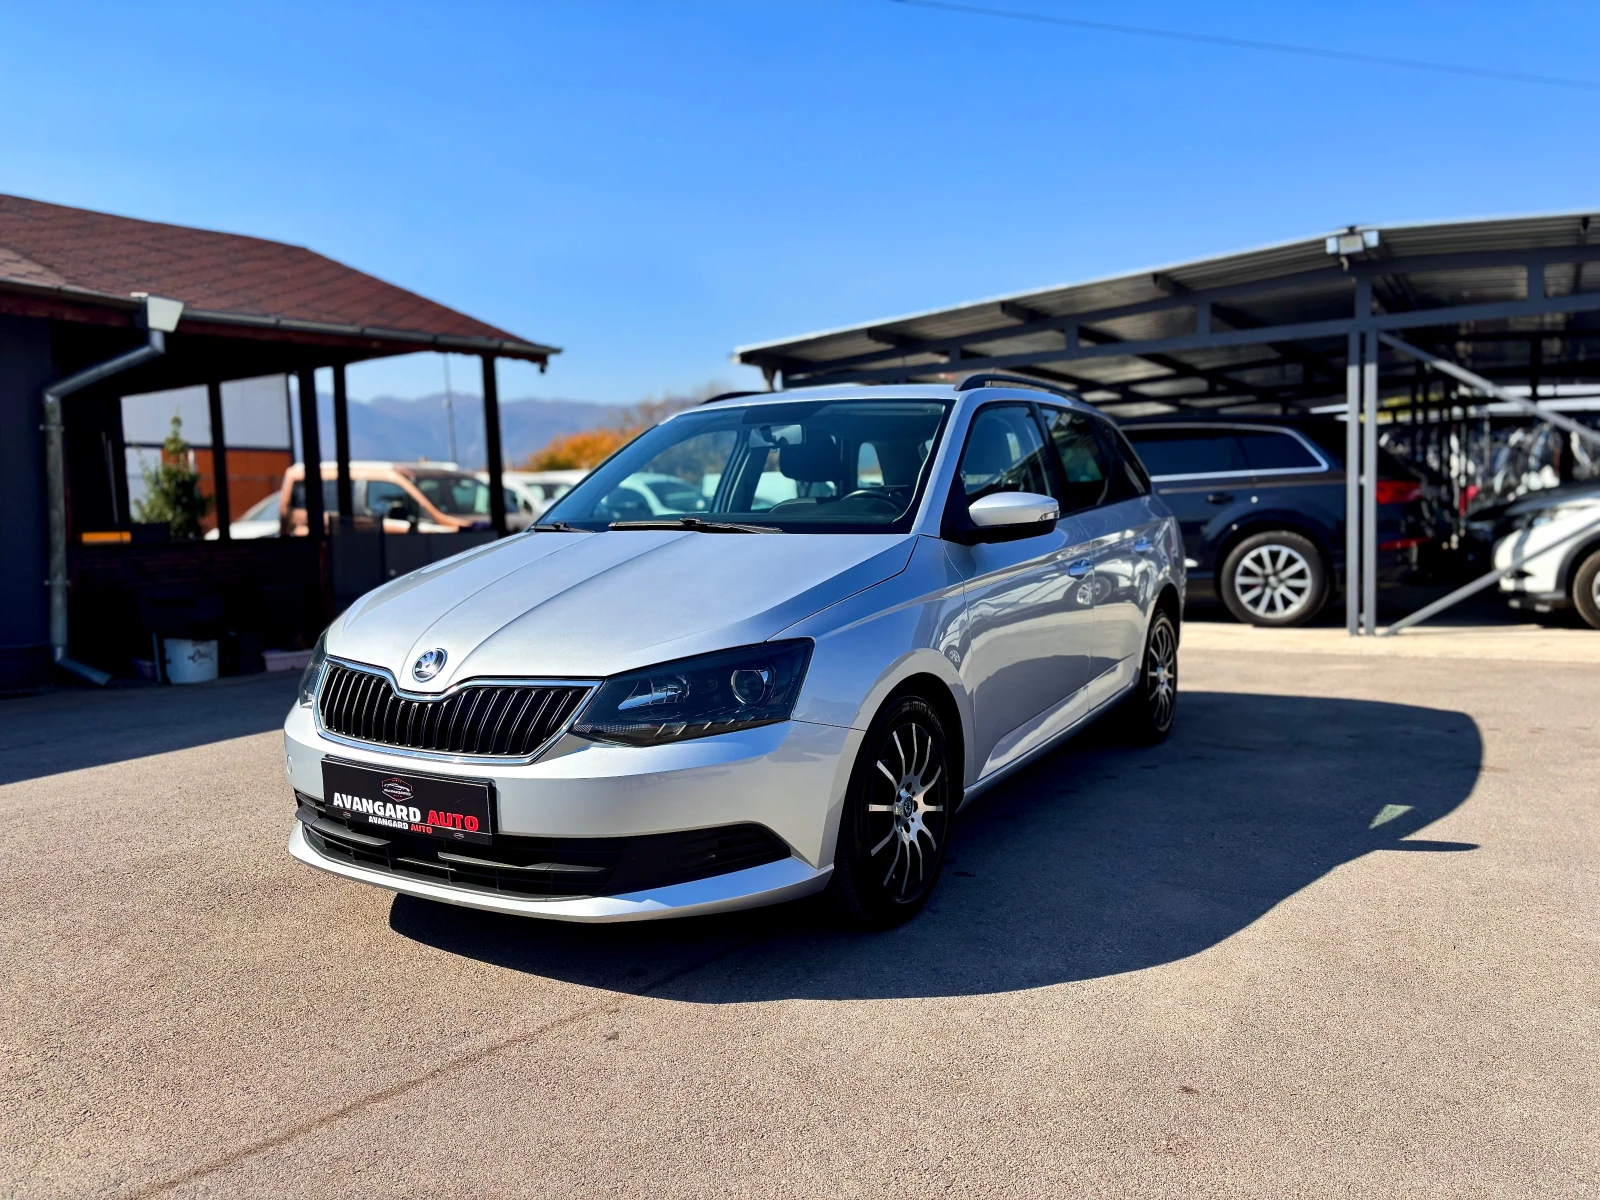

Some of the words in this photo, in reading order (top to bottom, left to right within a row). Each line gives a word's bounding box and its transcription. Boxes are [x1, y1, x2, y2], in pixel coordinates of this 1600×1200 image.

[333, 792, 421, 823] AVANGARD
[427, 810, 479, 832] AUTO
[368, 815, 409, 830] AVANGARD
[410, 823, 433, 834] AUTO
